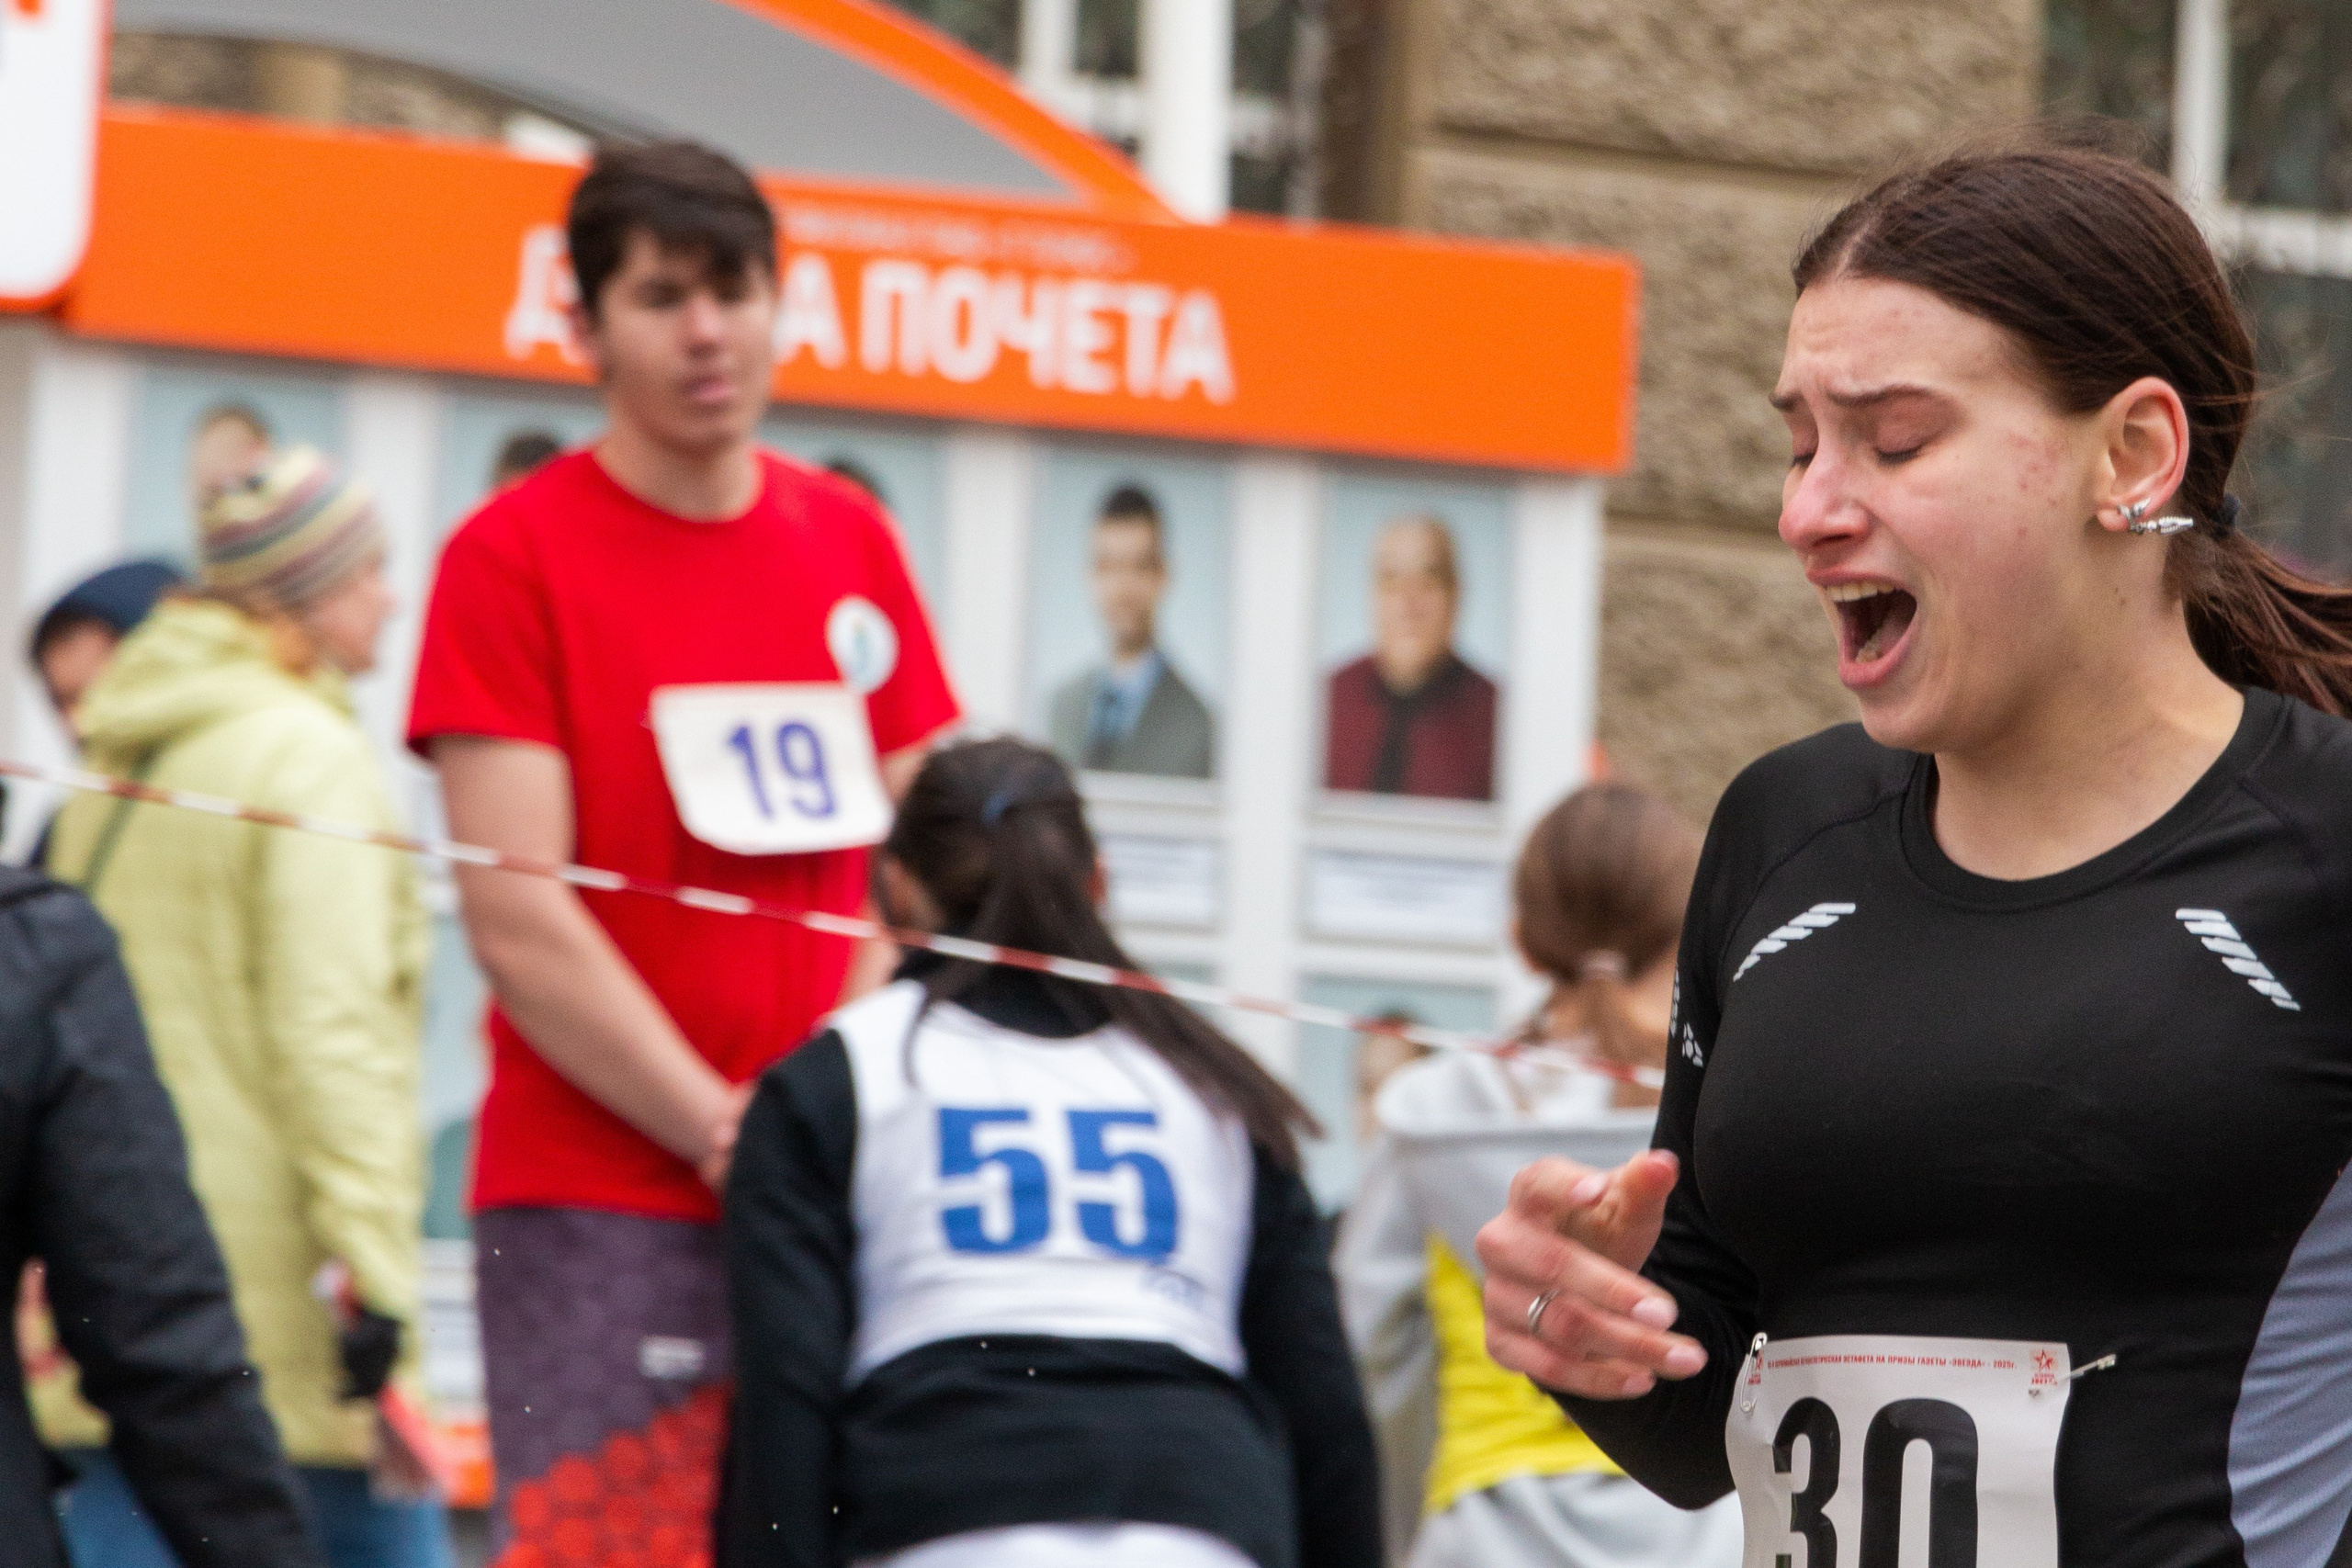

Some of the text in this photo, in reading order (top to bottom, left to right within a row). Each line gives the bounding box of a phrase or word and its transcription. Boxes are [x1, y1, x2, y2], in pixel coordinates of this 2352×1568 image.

[859, 258, 1235, 406] ПОЧЕТА
[725, 720, 838, 820] 19
[935, 1106, 1180, 1266] 55
[1875, 1354, 1885, 1364] НА
[1887, 1355, 1916, 1366] ПРИЗЫ
[1917, 1356, 1947, 1367] ГАЗЕТЫ
[1772, 1395, 1978, 1568] 30
